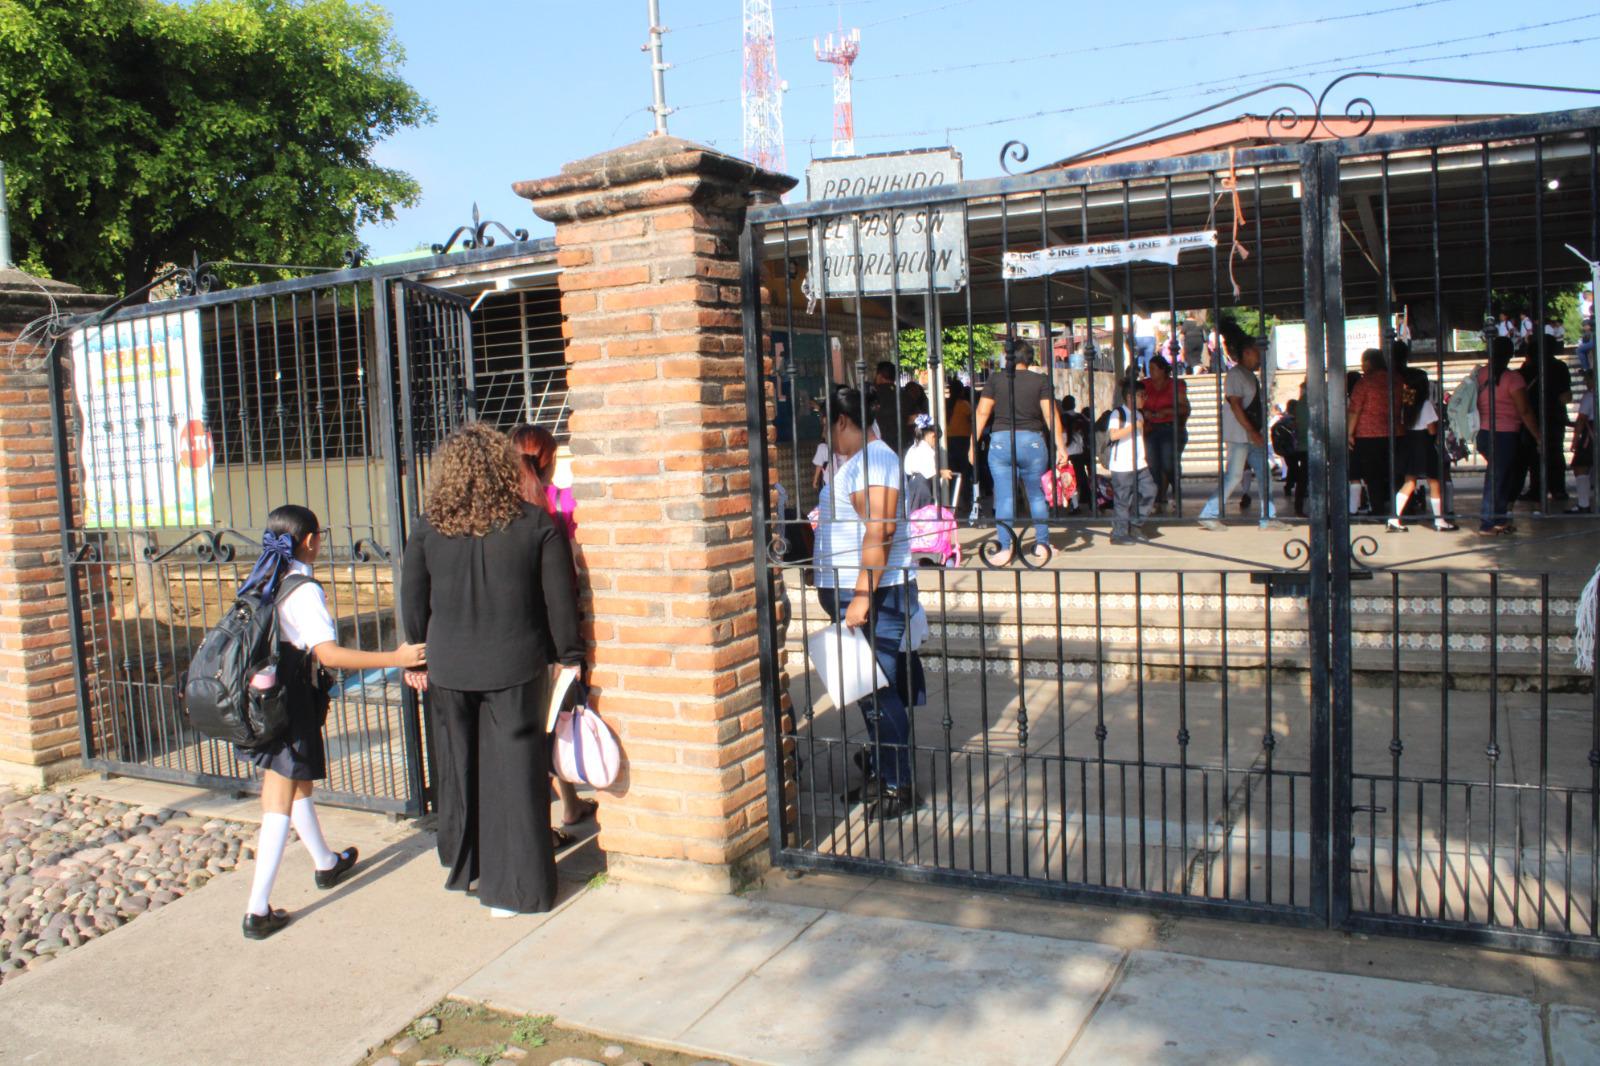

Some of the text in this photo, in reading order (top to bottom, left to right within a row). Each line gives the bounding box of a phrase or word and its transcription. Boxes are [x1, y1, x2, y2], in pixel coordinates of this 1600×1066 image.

[823, 214, 844, 239] EL
[1058, 248, 1080, 256] INE
[1096, 245, 1121, 254] INE
[1138, 240, 1161, 248] INE
[1179, 235, 1203, 243] INE
[181, 434, 211, 451] ATO
